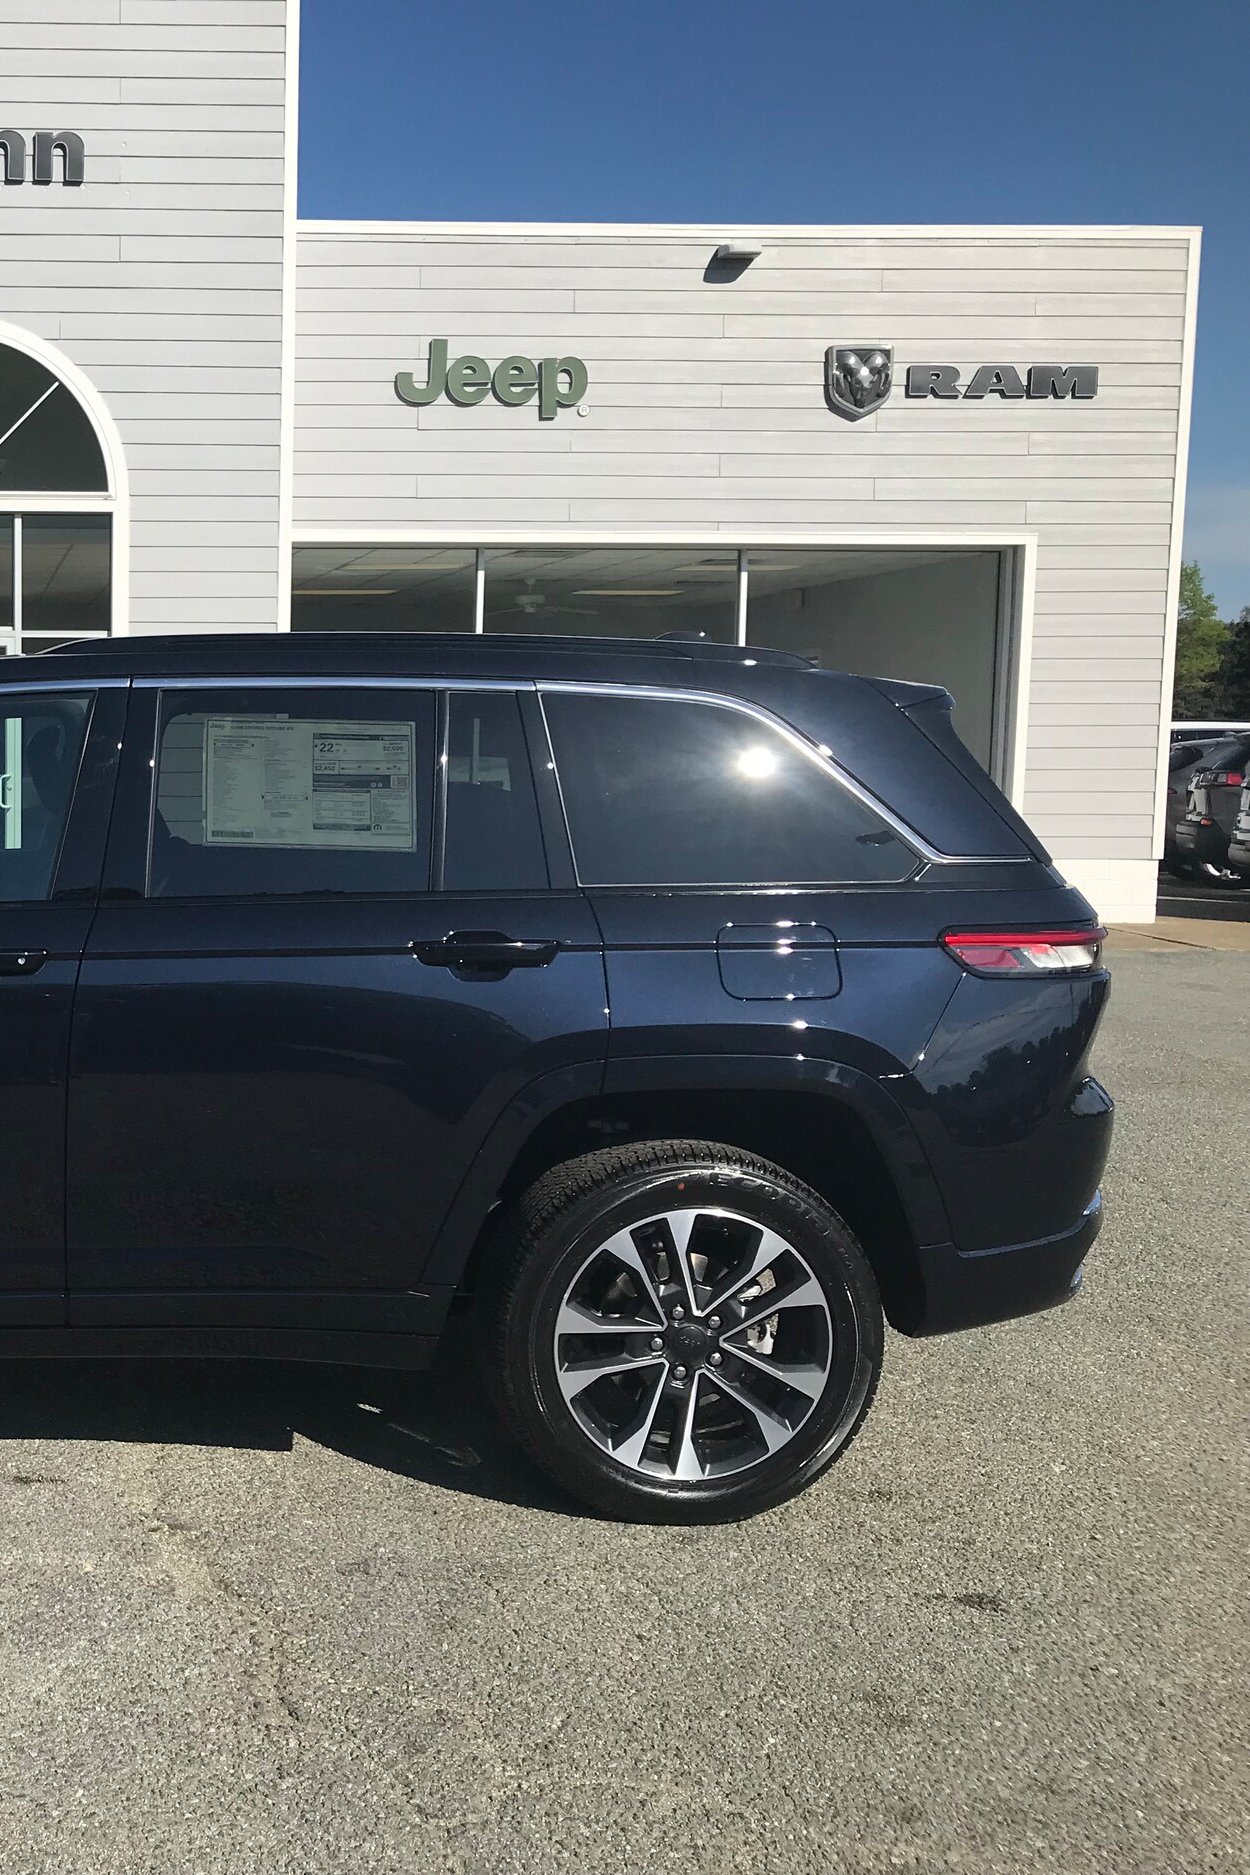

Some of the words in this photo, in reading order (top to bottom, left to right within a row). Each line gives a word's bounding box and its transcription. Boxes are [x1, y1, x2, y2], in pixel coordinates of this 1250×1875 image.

[394, 338, 588, 421] Jeep
[904, 365, 1099, 400] RAM
[319, 742, 334, 753] 22
